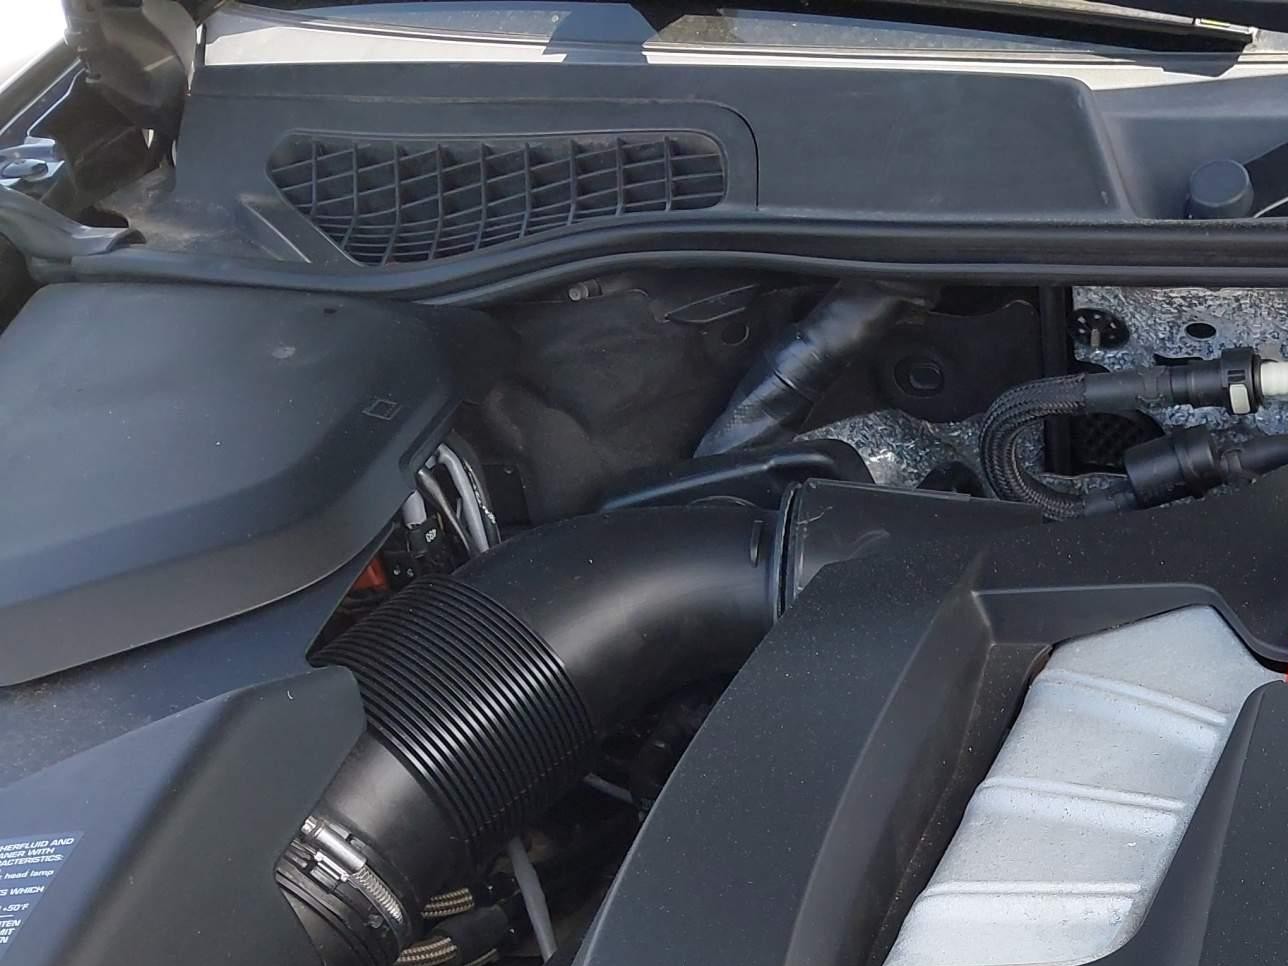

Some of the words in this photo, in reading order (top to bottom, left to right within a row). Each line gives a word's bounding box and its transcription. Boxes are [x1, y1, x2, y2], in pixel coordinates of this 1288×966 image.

[50, 838, 74, 847] AND
[28, 847, 55, 856] WITH
[4, 867, 30, 880] head
[30, 869, 54, 877] lamp
[10, 886, 45, 896] WHICH
